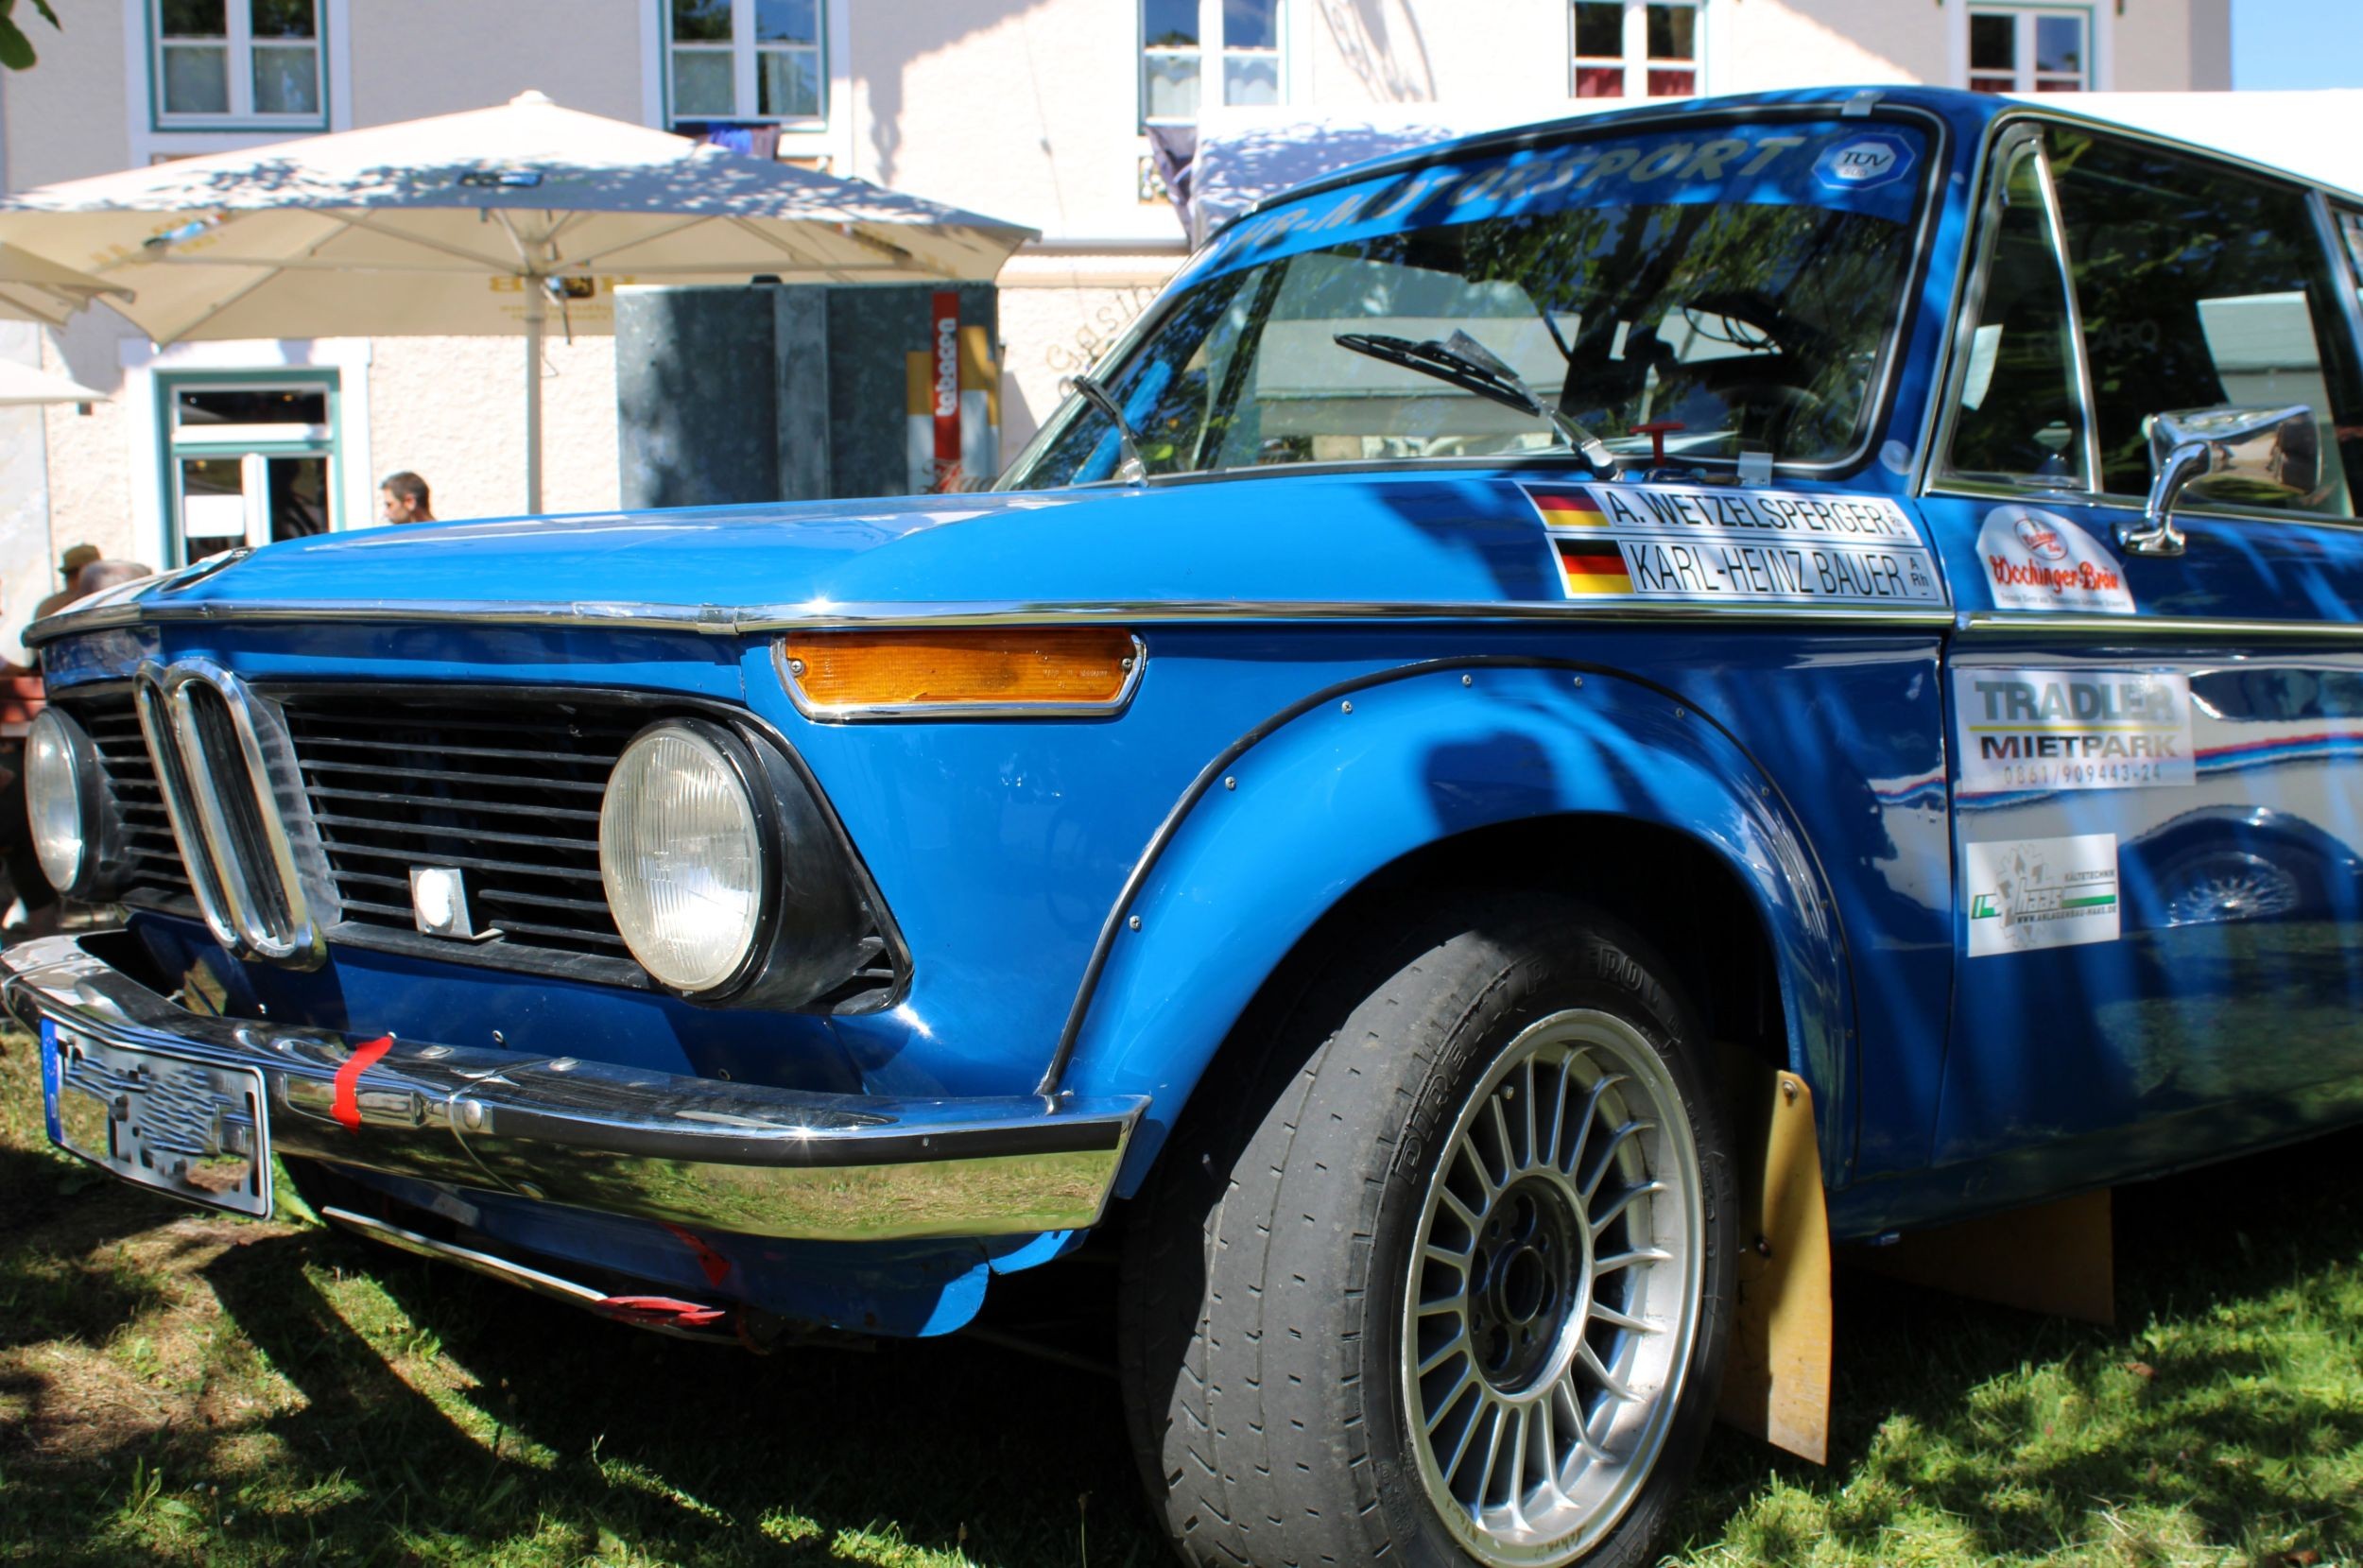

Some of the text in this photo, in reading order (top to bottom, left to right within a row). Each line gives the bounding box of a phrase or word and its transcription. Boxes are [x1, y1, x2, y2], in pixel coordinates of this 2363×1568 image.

[1644, 492, 1894, 535] WETZELSPERGER
[1630, 544, 1907, 596] KARL-HEINZ BAUER
[1975, 681, 2176, 721] TRADLER
[1981, 735, 2178, 760] MIETPARK
